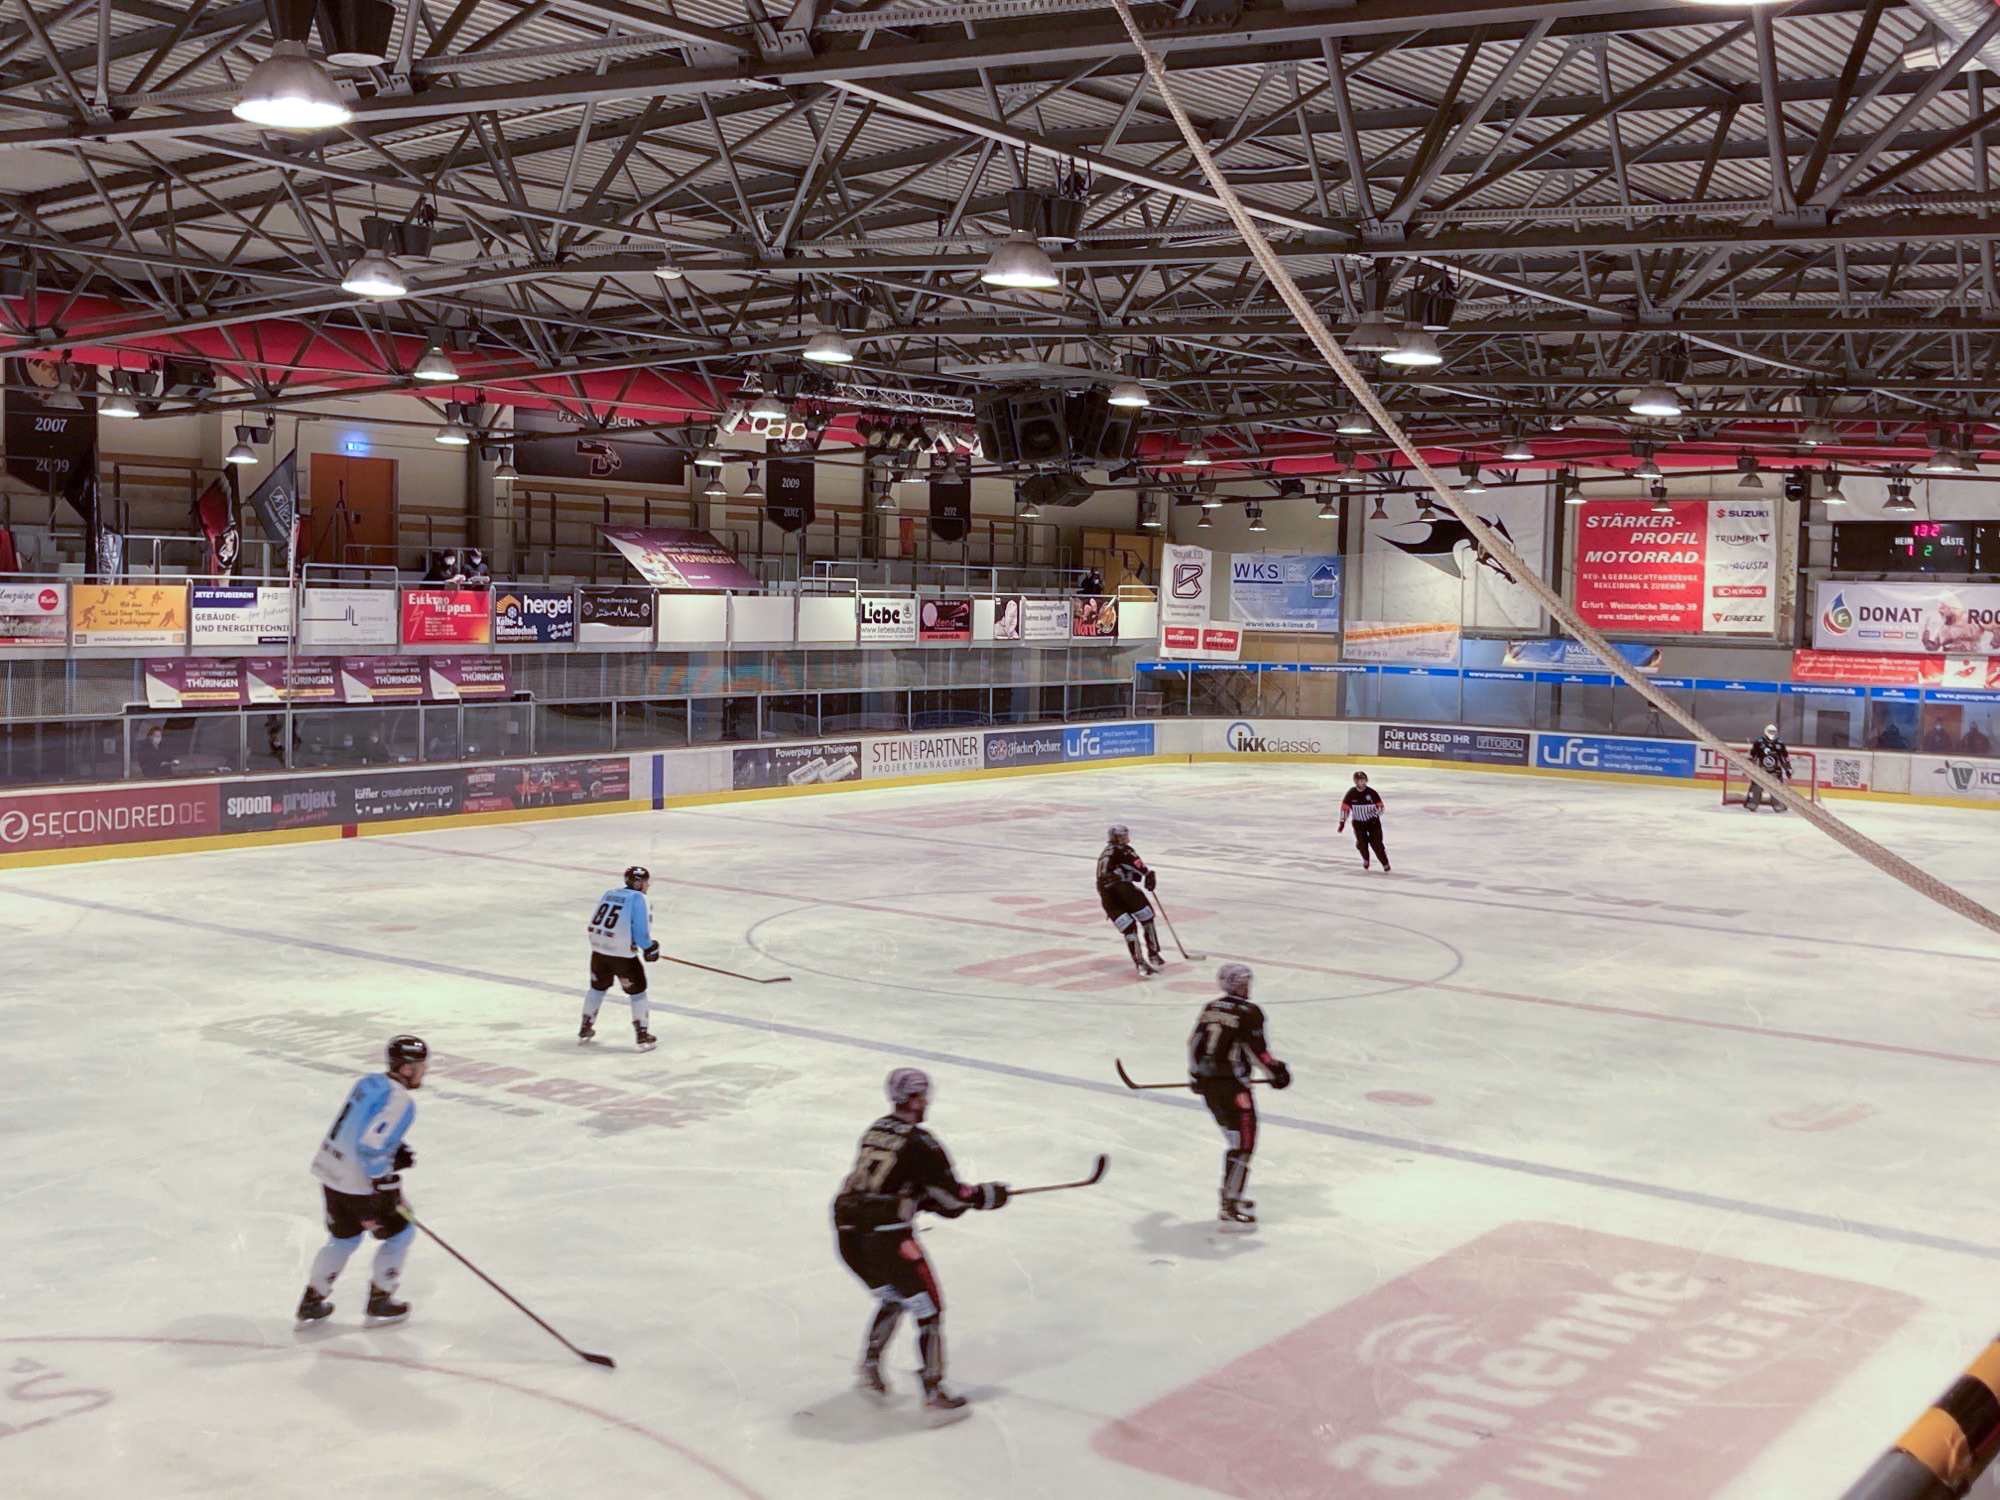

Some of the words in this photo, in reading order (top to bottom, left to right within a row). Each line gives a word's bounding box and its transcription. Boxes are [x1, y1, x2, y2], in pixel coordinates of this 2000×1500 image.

[35, 417, 68, 432] 2007
[782, 478, 800, 488] 2009
[1586, 512, 1682, 528] STÄRKER-
[1728, 510, 1769, 518] SUZUKI
[1630, 532, 1699, 545] PROFIL
[1715, 534, 1758, 542] TRIUMPH
[1940, 536, 1964, 546] GÄSTE
[1924, 545, 1932, 556] 2
[1585, 551, 1699, 564] MOTORRAD
[1234, 563, 1278, 578] WKS
[524, 594, 572, 618] herget
[1582, 601, 1604, 609] Erfurt
[1610, 602, 1658, 610] Weimarische
[195, 612, 240, 621] GEBÄUDE-
[862, 602, 900, 624] Liebe
[1859, 606, 1922, 623] DONAT
[195, 624, 214, 632] UND
[496, 625, 538, 635] Klimatechnik
[1206, 636, 1234, 644] antenne
[186, 678, 238, 688] THÜRINGEN
[375, 674, 422, 684] THÜRINGEN
[462, 672, 504, 682] THÜRINGEN
[1384, 729, 1406, 740] FÜR
[1407, 732, 1428, 741] UNS
[1430, 733, 1452, 742] SEID
[1453, 734, 1470, 744] IHR
[776, 747, 812, 758] Powerplay
[824, 744, 858, 755] Thüringen
[872, 741, 912, 762] STEIN
[920, 736, 978, 760] PARTNER
[1268, 738, 1321, 754] classic
[1384, 741, 1400, 750] DIE
[1402, 742, 1445, 752] HELDEN!
[1490, 740, 1521, 750] TOBOL
[872, 757, 978, 774] PROJEKTMANAGEMENT
[355, 788, 380, 800] löffler
[227, 796, 272, 818] spoon
[32, 802, 206, 837] SECONDRED.DE
[592, 903, 623, 930] 85
[1324, 1270, 1704, 1487] antenne
